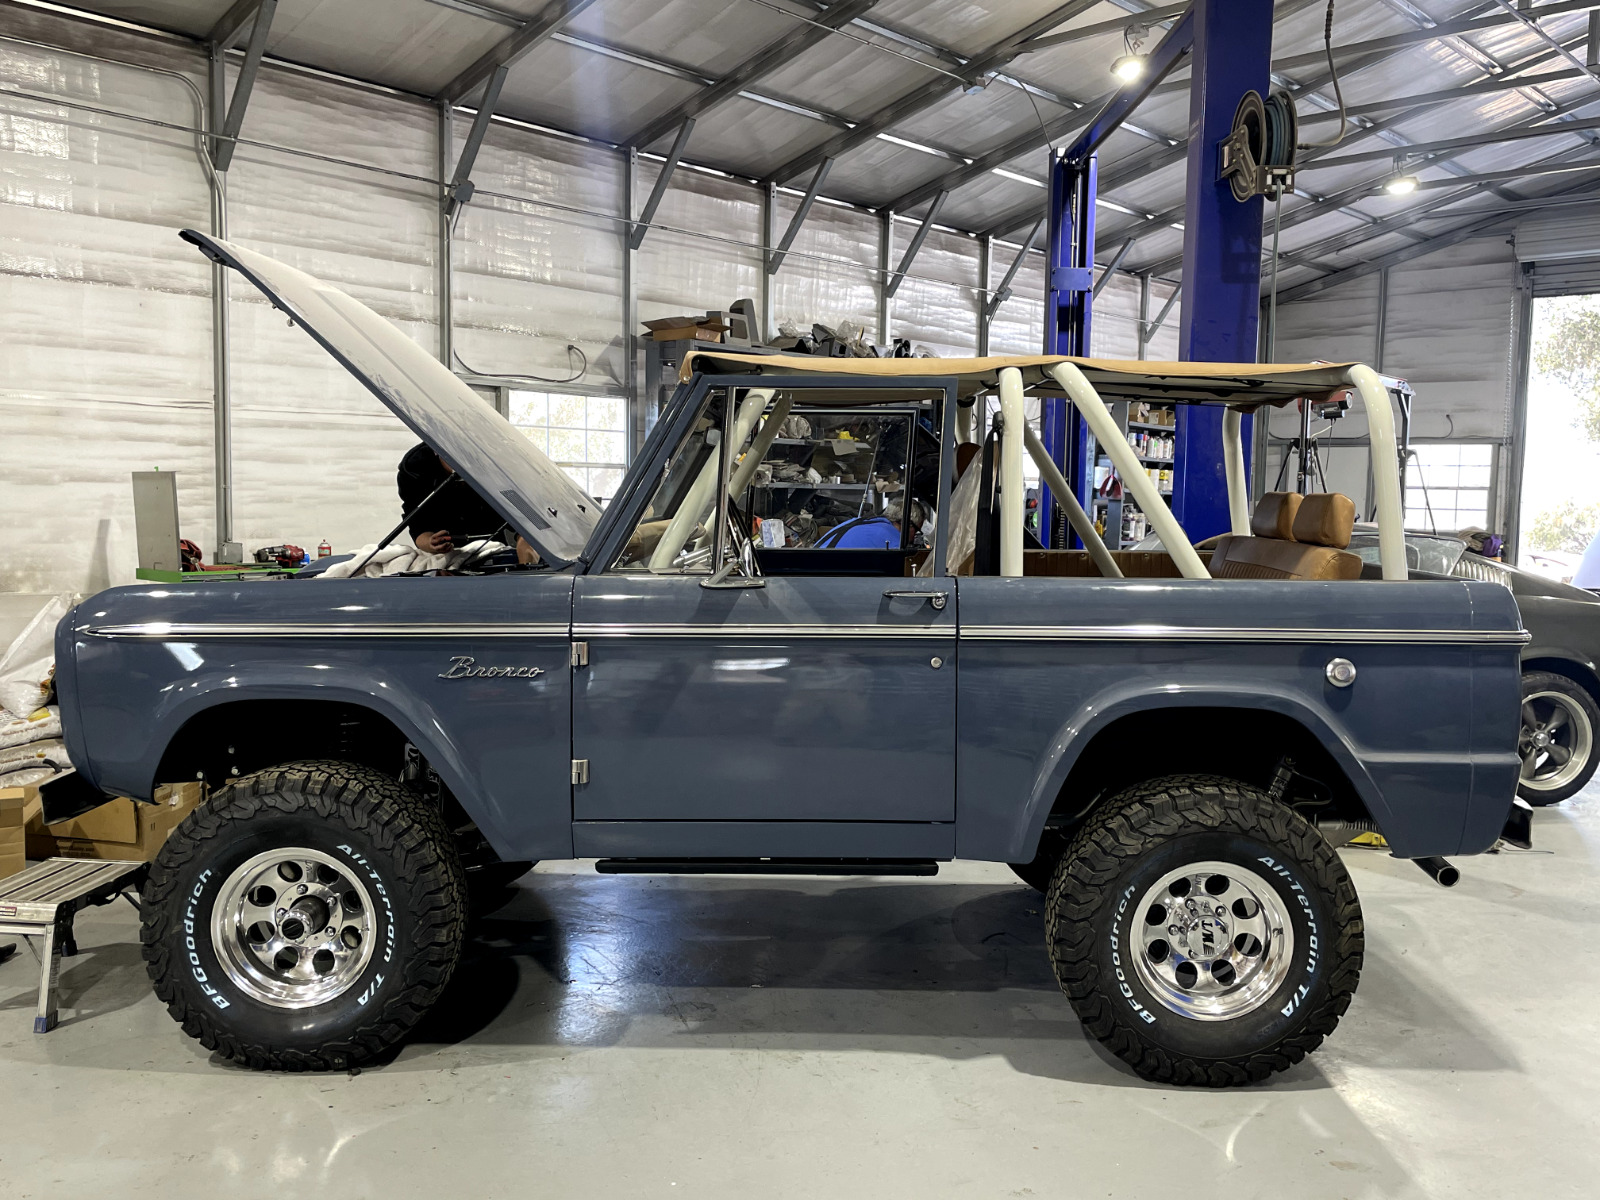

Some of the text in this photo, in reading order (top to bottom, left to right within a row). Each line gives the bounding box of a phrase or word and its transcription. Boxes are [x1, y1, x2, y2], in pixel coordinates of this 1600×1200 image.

[438, 656, 544, 679] Bronco
[183, 869, 232, 1009] BFGoodrich
[336, 843, 396, 1006] All-Terrain T/A
[1110, 884, 1157, 1024] BFGoodrich
[1257, 856, 1318, 1018] All-Terrain T/A
